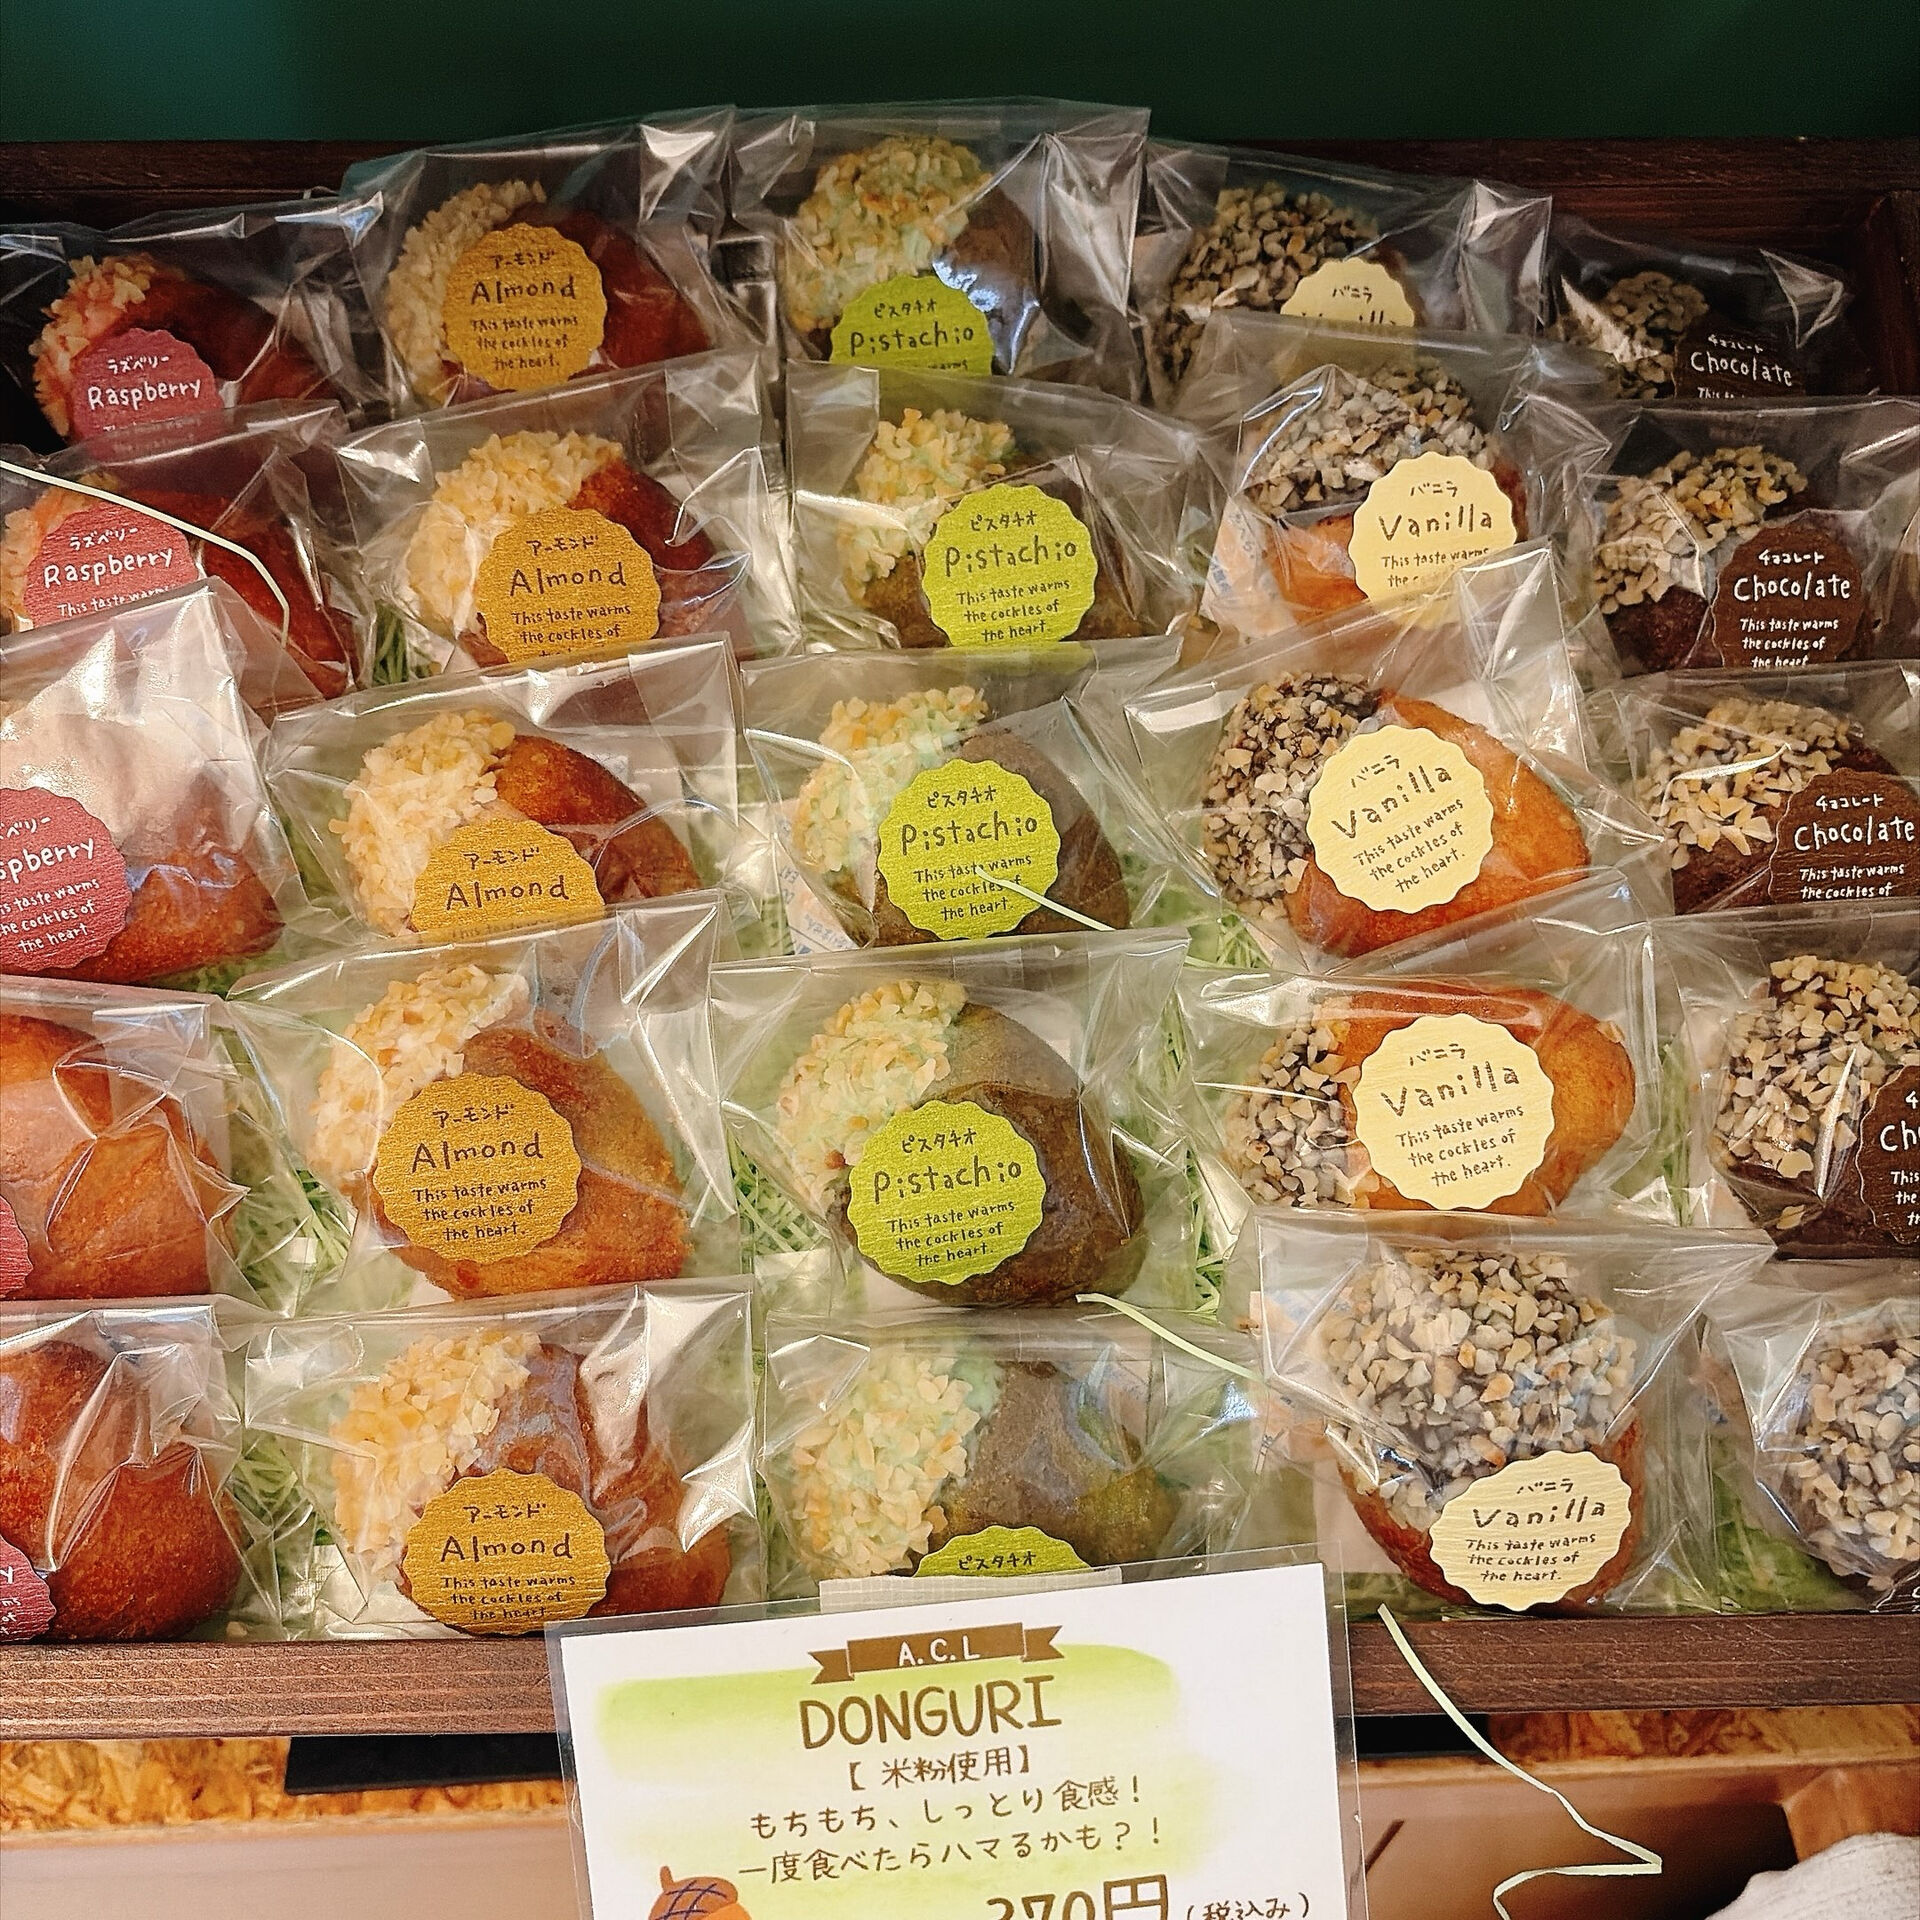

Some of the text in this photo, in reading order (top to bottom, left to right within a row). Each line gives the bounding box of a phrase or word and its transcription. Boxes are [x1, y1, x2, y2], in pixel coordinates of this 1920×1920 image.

[471, 275, 576, 305] Almond
[1332, 286, 1372, 304] バニラ
[875, 299, 936, 318] ピスタチオ
[472, 316, 578, 332] This taste warms
[477, 334, 568, 349] the cockles of
[108, 356, 169, 374] ラズベリー
[494, 357, 513, 369] the
[1691, 351, 1792, 387] Chocolate
[88, 379, 201, 410] Raspberry
[1410, 481, 1458, 497] バニラ
[971, 510, 1037, 531] ピスタチオ
[1379, 504, 1492, 541] Vanilla
[70, 527, 138, 550] ラズベリー
[526, 536, 598, 556] アーモンド
[44, 548, 172, 588] Raspberry
[1382, 552, 1446, 569] This taste
[1758, 549, 1825, 565] チョコレート
[510, 562, 626, 596] Almond
[1388, 575, 1408, 587] the
[1734, 571, 1850, 601] Chocolate
[957, 580, 1070, 605] This taste warms
[58, 603, 87, 616] This
[512, 605, 631, 625] This taste warms
[964, 599, 1060, 622] the cockles of
[520, 624, 621, 643] the cockles of
[981, 629, 1004, 642] the
[1740, 618, 1839, 632] This taste warms
[1742, 636, 1826, 650] the cockles of
[1752, 656, 1770, 668] the
[1351, 754, 1400, 788] バニラ
[927, 785, 996, 808] ピスタチオ
[1331, 765, 1451, 838] Vanilla
[1816, 794, 1883, 812] チョコレート
[1353, 799, 1464, 866] This taste warms
[1795, 816, 1915, 850] Chocolate
[464, 847, 539, 869] アーモンド
[1370, 822, 1463, 881] the cockles of
[914, 856, 1032, 883] This warms
[1395, 848, 1465, 893] the heart.
[1800, 864, 1904, 881] This taste warms
[14, 878, 100, 911] taste warms
[447, 875, 569, 910] Almond
[923, 890, 946, 902] the
[1801, 882, 1892, 899] the cockles of
[22, 900, 95, 931] cockles of
[942, 907, 964, 922] the
[18, 937, 44, 953] the
[1409, 1043, 1465, 1066] バニラ
[1380, 1061, 1520, 1117] Vanilla
[433, 1103, 514, 1128] アーモンド
[1396, 1106, 1524, 1147] This taste warms
[902, 1128, 977, 1153] ピスタチオ
[1408, 1128, 1516, 1168] the cockles of
[411, 1132, 544, 1174] Almond
[1432, 1155, 1511, 1187] the heart.
[412, 1179, 546, 1202] This taste warms
[1895, 1191, 1916, 1205] the
[422, 1200, 535, 1221] the cockles of
[887, 1201, 1015, 1233] This taste warms
[443, 1222, 525, 1241] the heart.
[896, 1222, 1004, 1251] the cockles of
[916, 1243, 993, 1267] the heart.
[1517, 1478, 1573, 1494] バニラ
[463, 1503, 546, 1523] アーモンド
[1473, 1496, 1605, 1528] Vanilla
[441, 1533, 573, 1562] Almond
[1466, 1534, 1596, 1551] This taste warms
[959, 1551, 1036, 1570] ピスタチオ
[1468, 1551, 1580, 1565] the cockles of
[441, 1576, 575, 1589] This taste warms
[1481, 1570, 1506, 1582] the
[451, 1592, 563, 1605] the cockles of
[472, 1610, 495, 1620] the
[899, 1635, 980, 1667] A.C.L
[800, 1674, 1062, 1750] DONGURI
